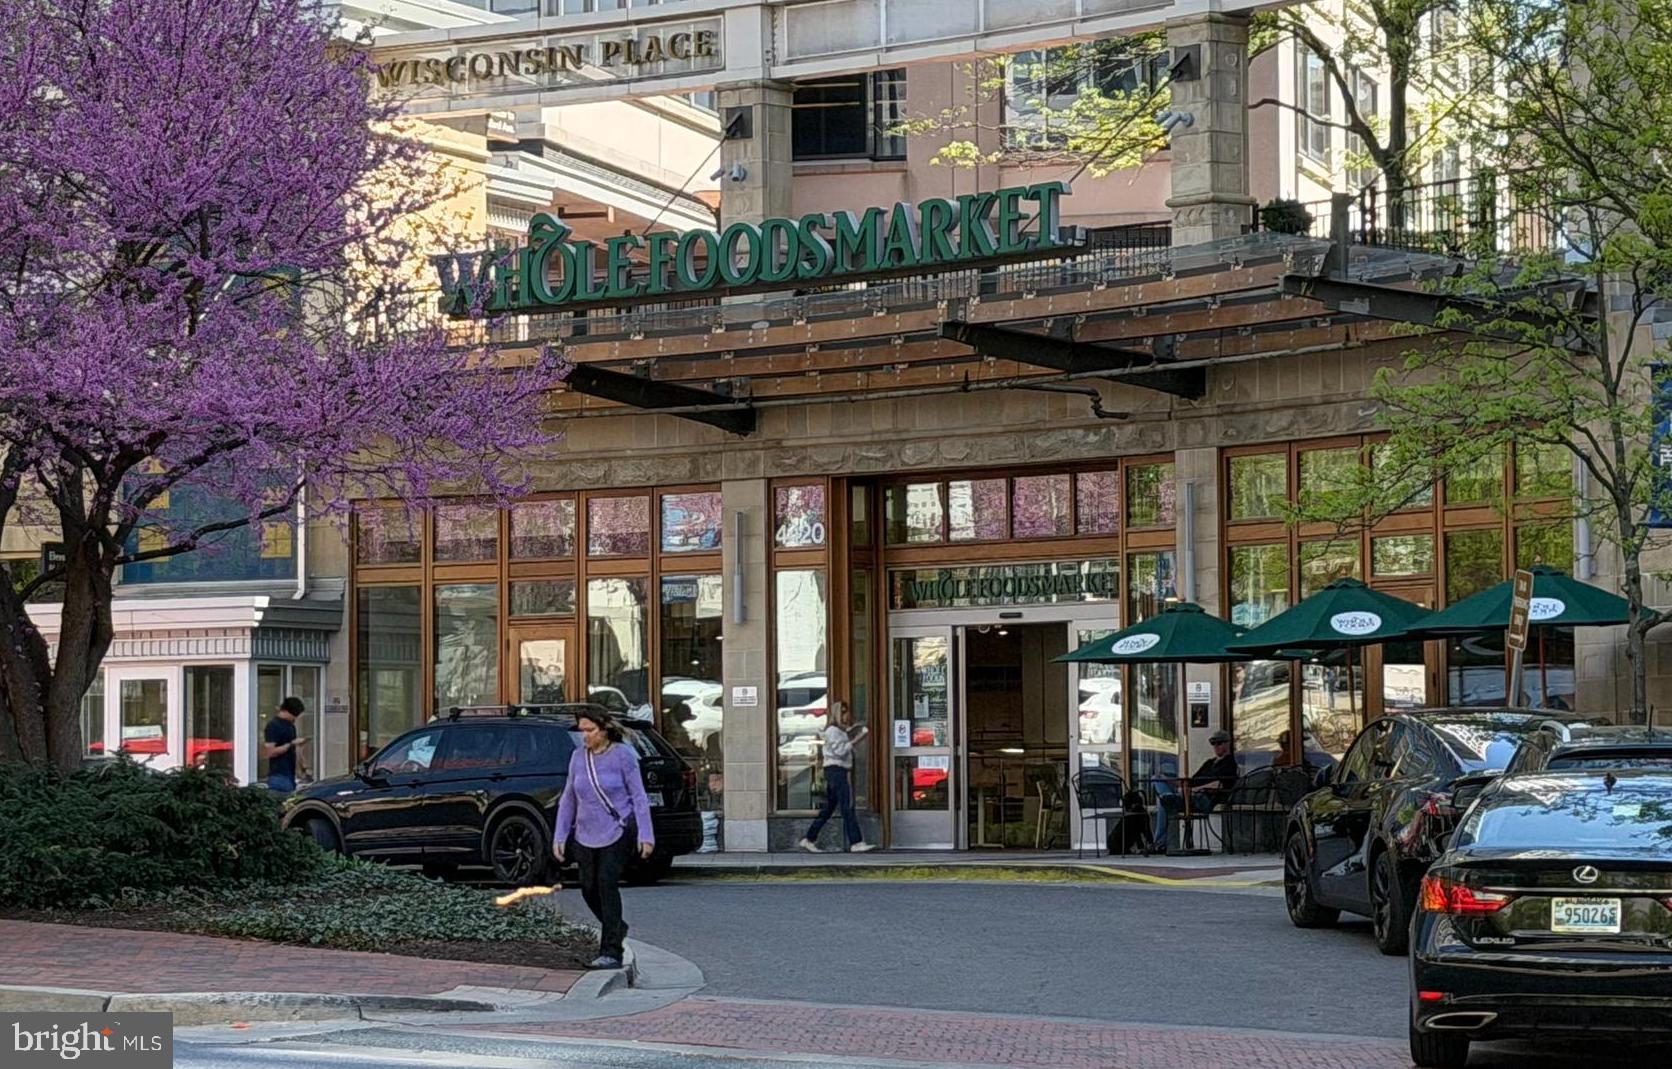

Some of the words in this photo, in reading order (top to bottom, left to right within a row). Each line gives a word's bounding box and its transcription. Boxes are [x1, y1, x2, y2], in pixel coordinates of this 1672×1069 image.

[376, 43, 584, 88] WISCONSIN
[600, 29, 718, 67] PLACE
[644, 213, 835, 293] FOODS
[831, 181, 1073, 273] MARKET
[1472, 936, 1516, 945] LEXUS
